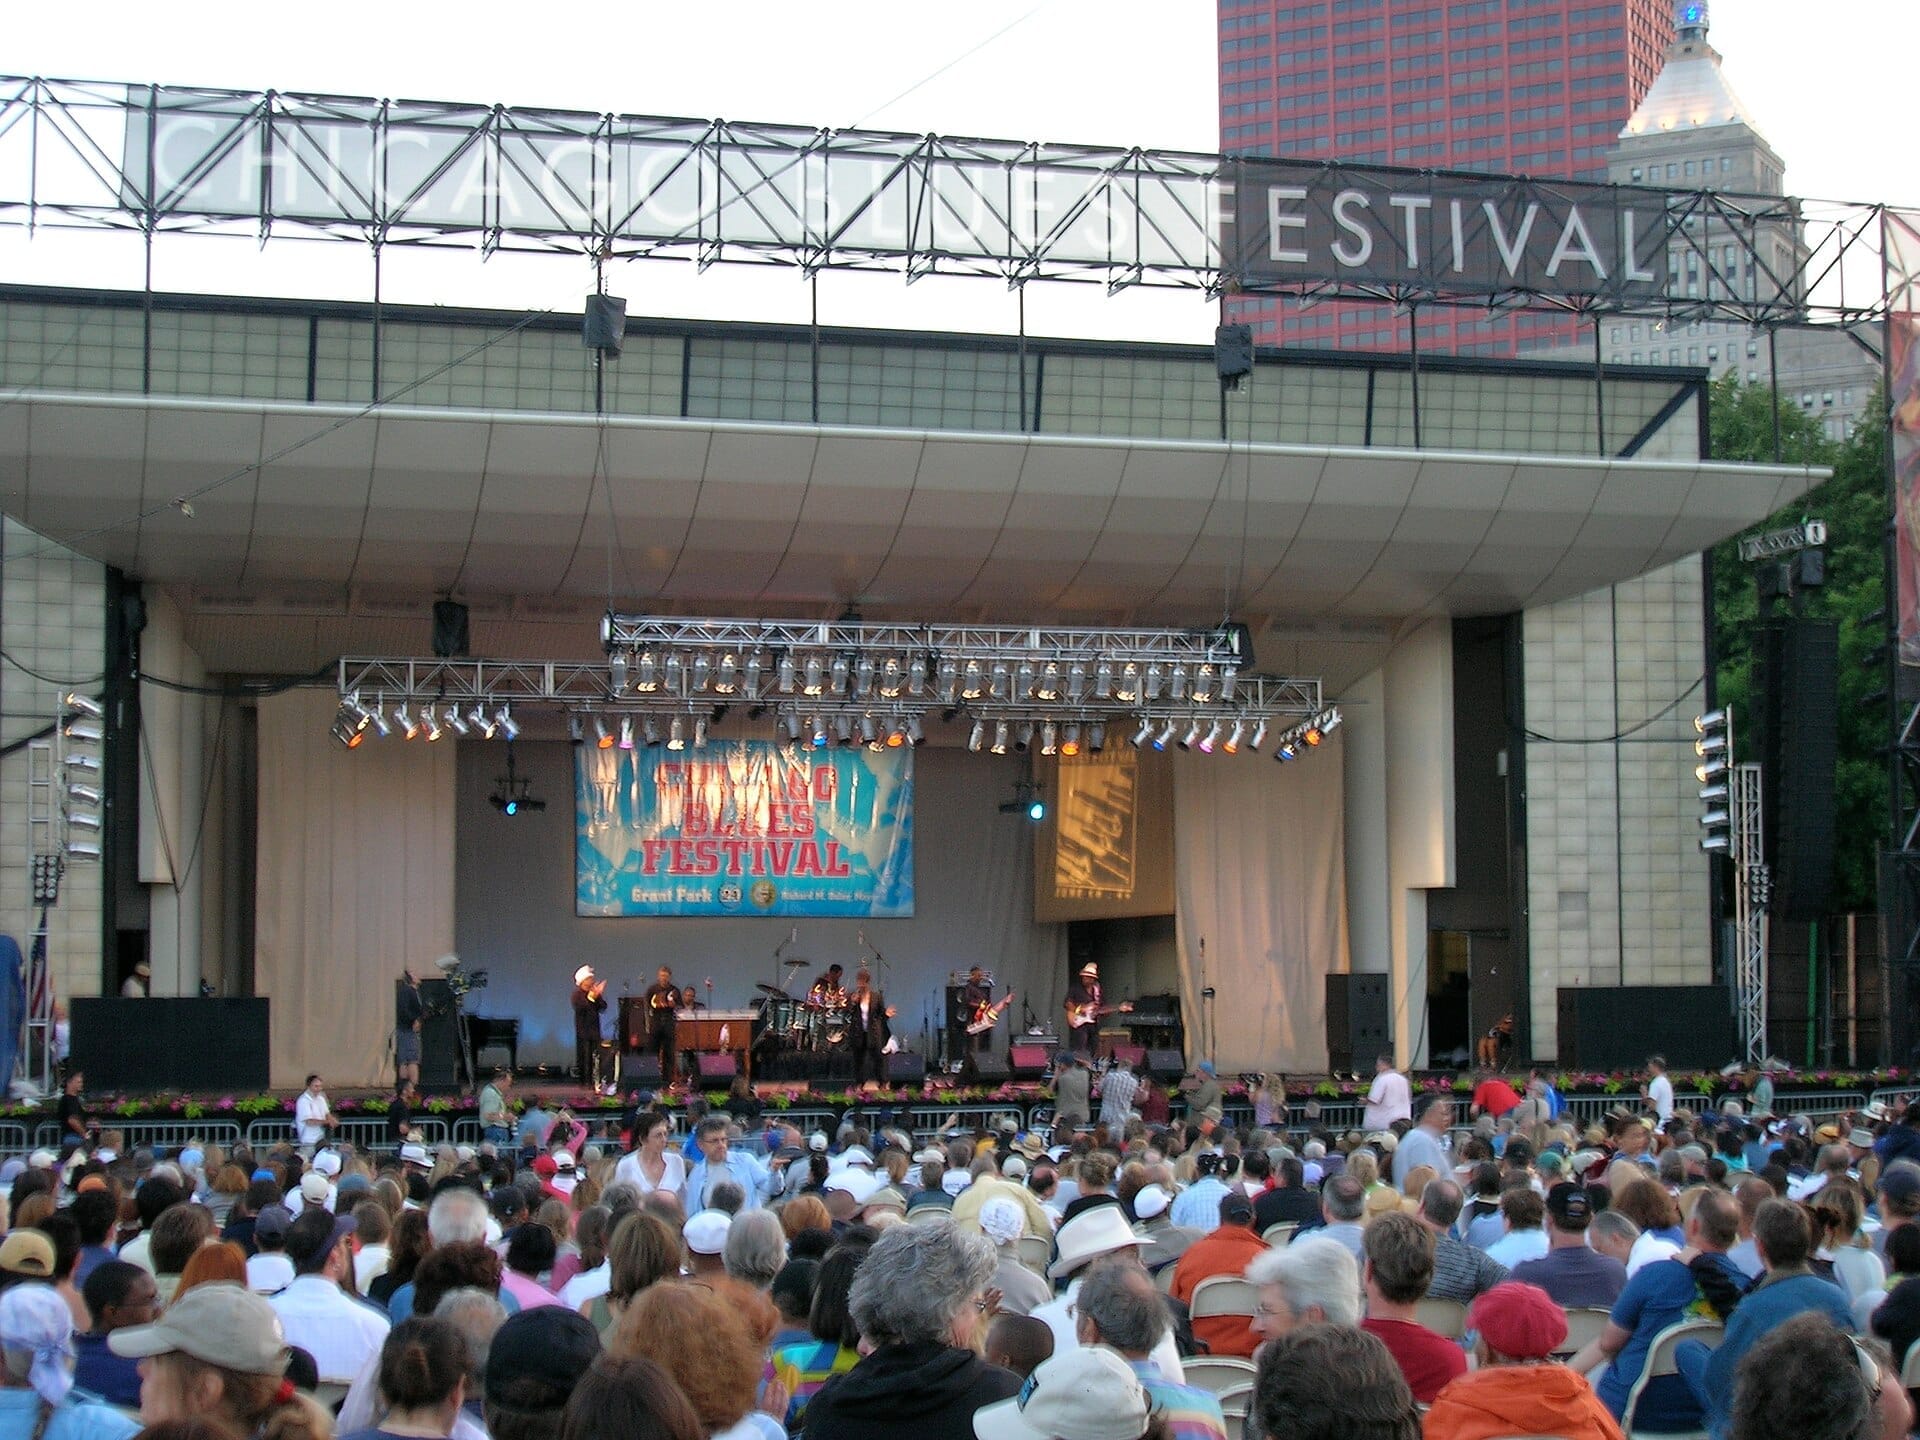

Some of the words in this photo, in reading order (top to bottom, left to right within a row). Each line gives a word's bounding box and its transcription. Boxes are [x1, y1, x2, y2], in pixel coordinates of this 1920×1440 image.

[154, 117, 718, 228] CHICAGO
[795, 154, 1129, 253] BLUES
[1201, 183, 1656, 283] FESTIVAL
[641, 839, 850, 877] FESTIVAL
[631, 885, 673, 903] Grant
[676, 884, 712, 903] Park
